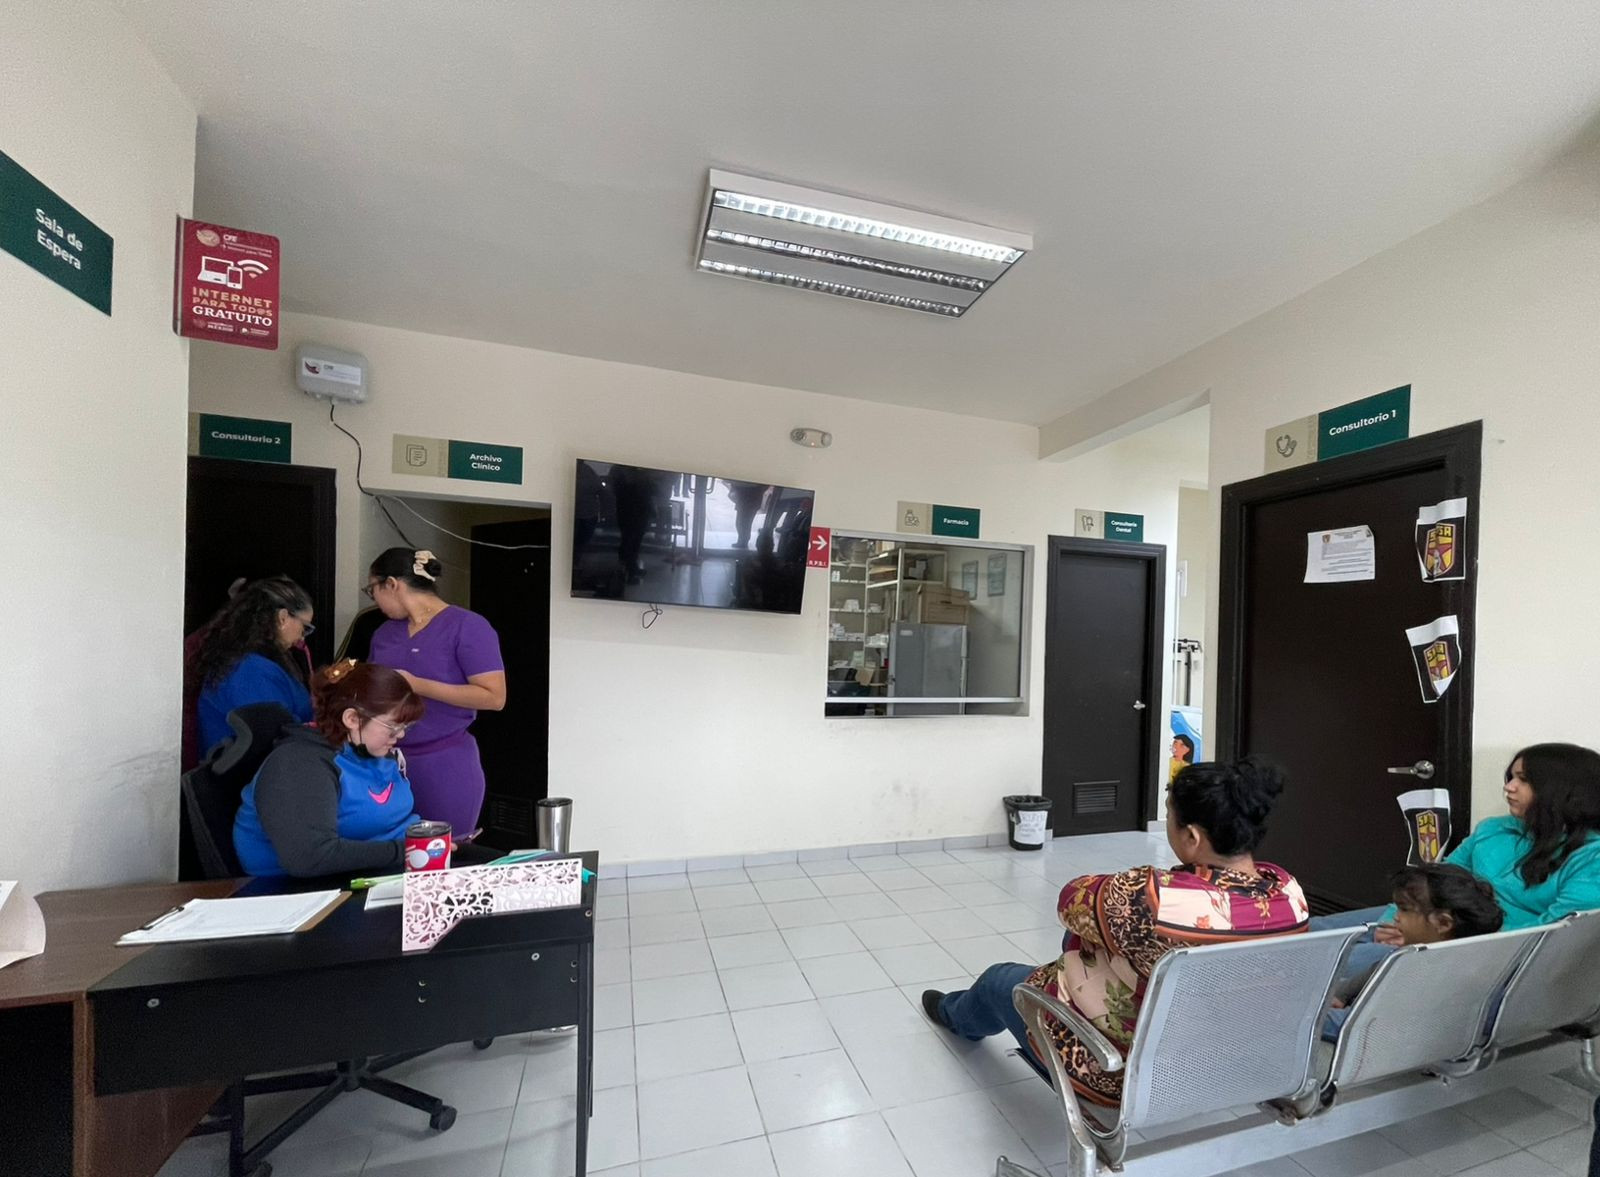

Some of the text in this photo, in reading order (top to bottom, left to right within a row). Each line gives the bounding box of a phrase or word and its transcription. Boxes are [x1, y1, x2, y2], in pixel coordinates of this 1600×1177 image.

[36, 208, 83, 251] Sala de
[37, 229, 81, 270] Espera
[192, 286, 272, 308] INTERNET
[192, 296, 227, 309] PARA
[192, 305, 273, 327] GRATUITO
[1329, 409, 1397, 436] Consultorio 1
[211, 431, 273, 444] Consultorio
[469, 453, 502, 463] Archivo
[943, 517, 969, 526] Farmacia
